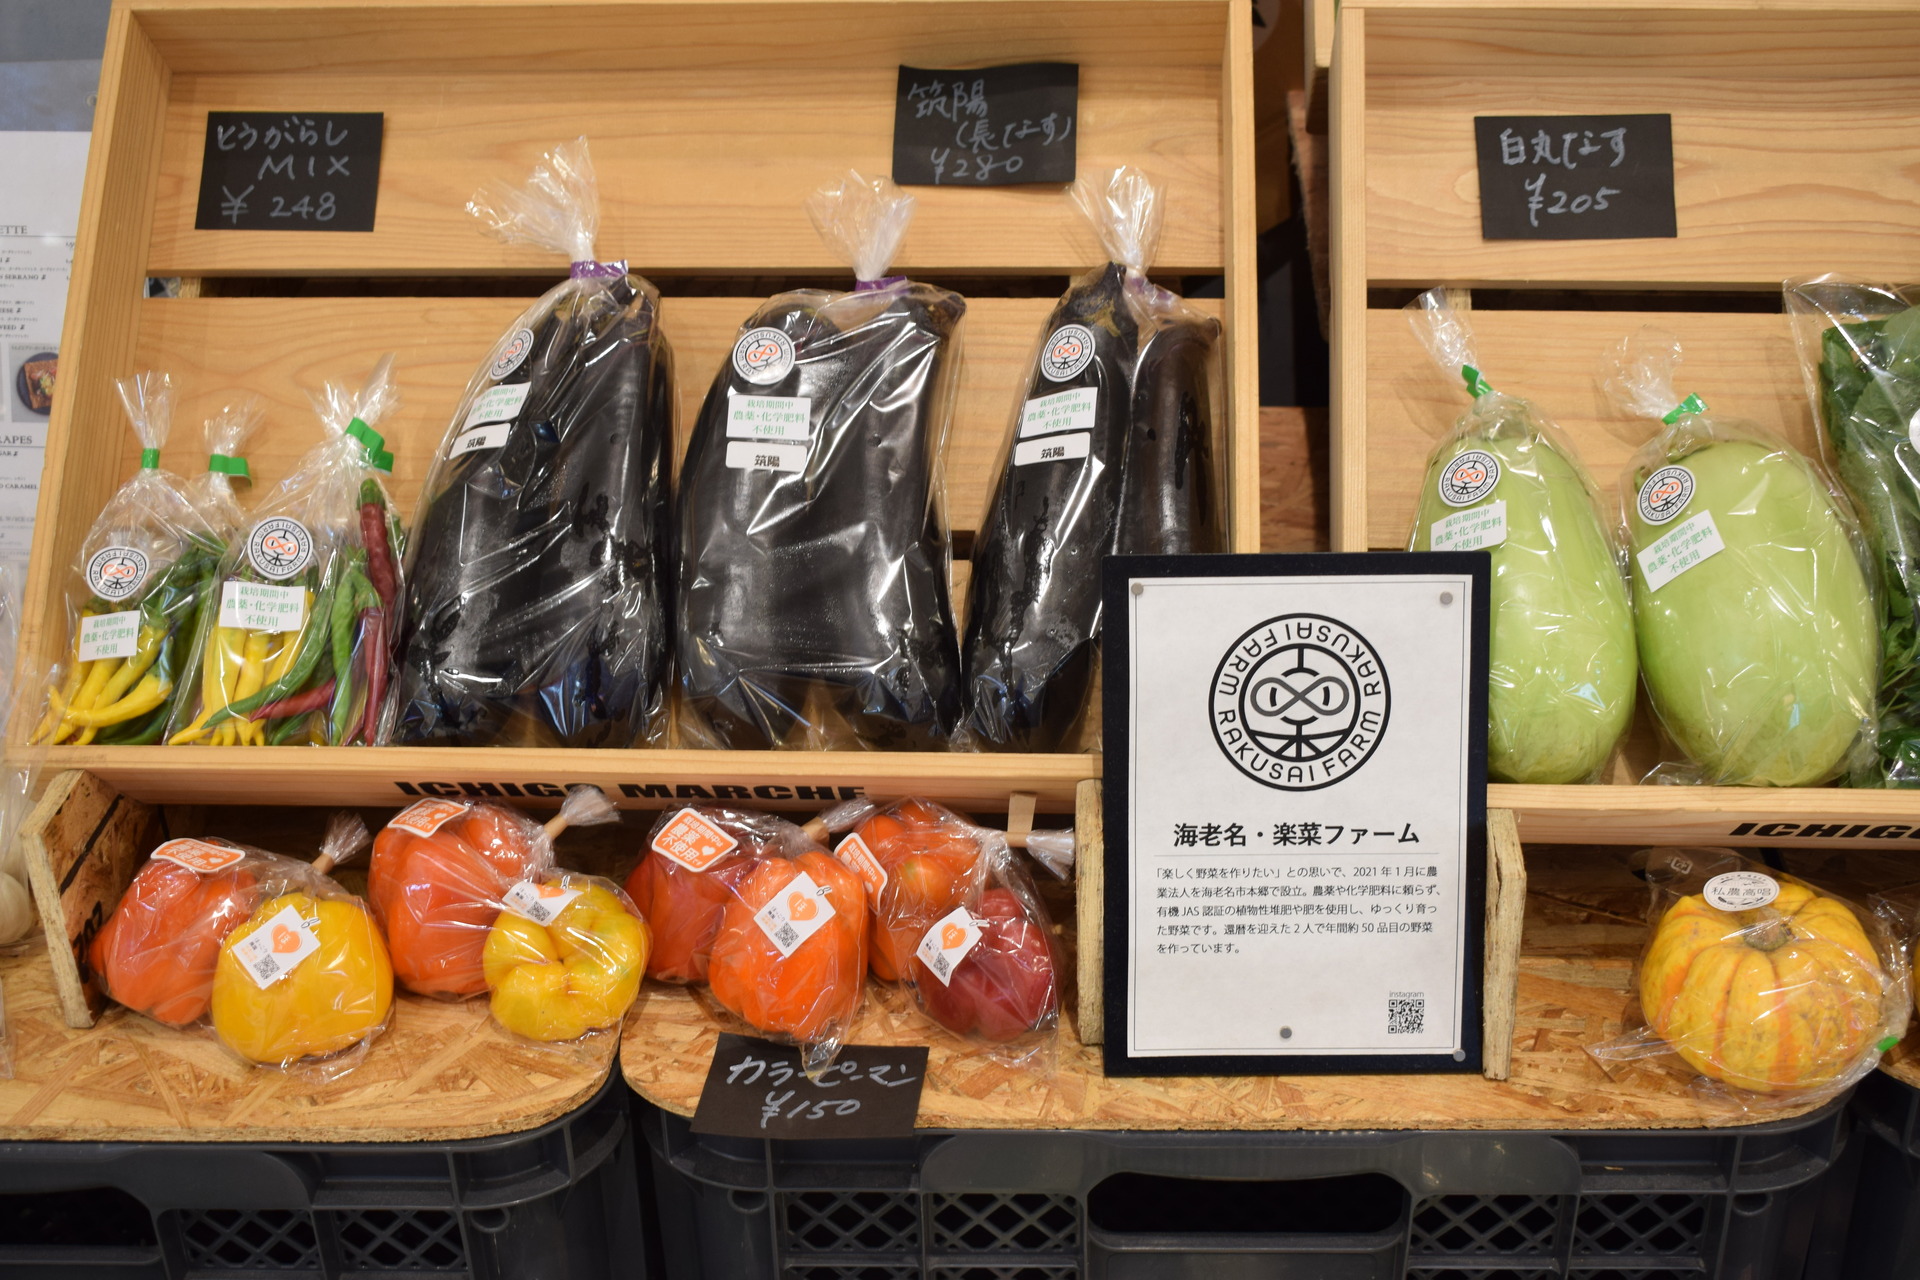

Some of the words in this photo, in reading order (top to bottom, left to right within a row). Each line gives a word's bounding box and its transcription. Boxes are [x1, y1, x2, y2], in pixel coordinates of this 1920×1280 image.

[216, 115, 348, 150] とうがらし
[1500, 128, 1627, 169] 白丸なす
[257, 154, 350, 180] MIX
[1524, 172, 1622, 228] ¥205
[752, 424, 785, 436] 不使用
[754, 454, 780, 468] 筑陽
[1040, 446, 1064, 459] 筑陽
[1174, 822, 1420, 847] 海老名・楽菜ファーム
[1728, 822, 1920, 840] ICHIG
[1156, 943, 1240, 954] を作っています。
[760, 1090, 861, 1129] ¥150
